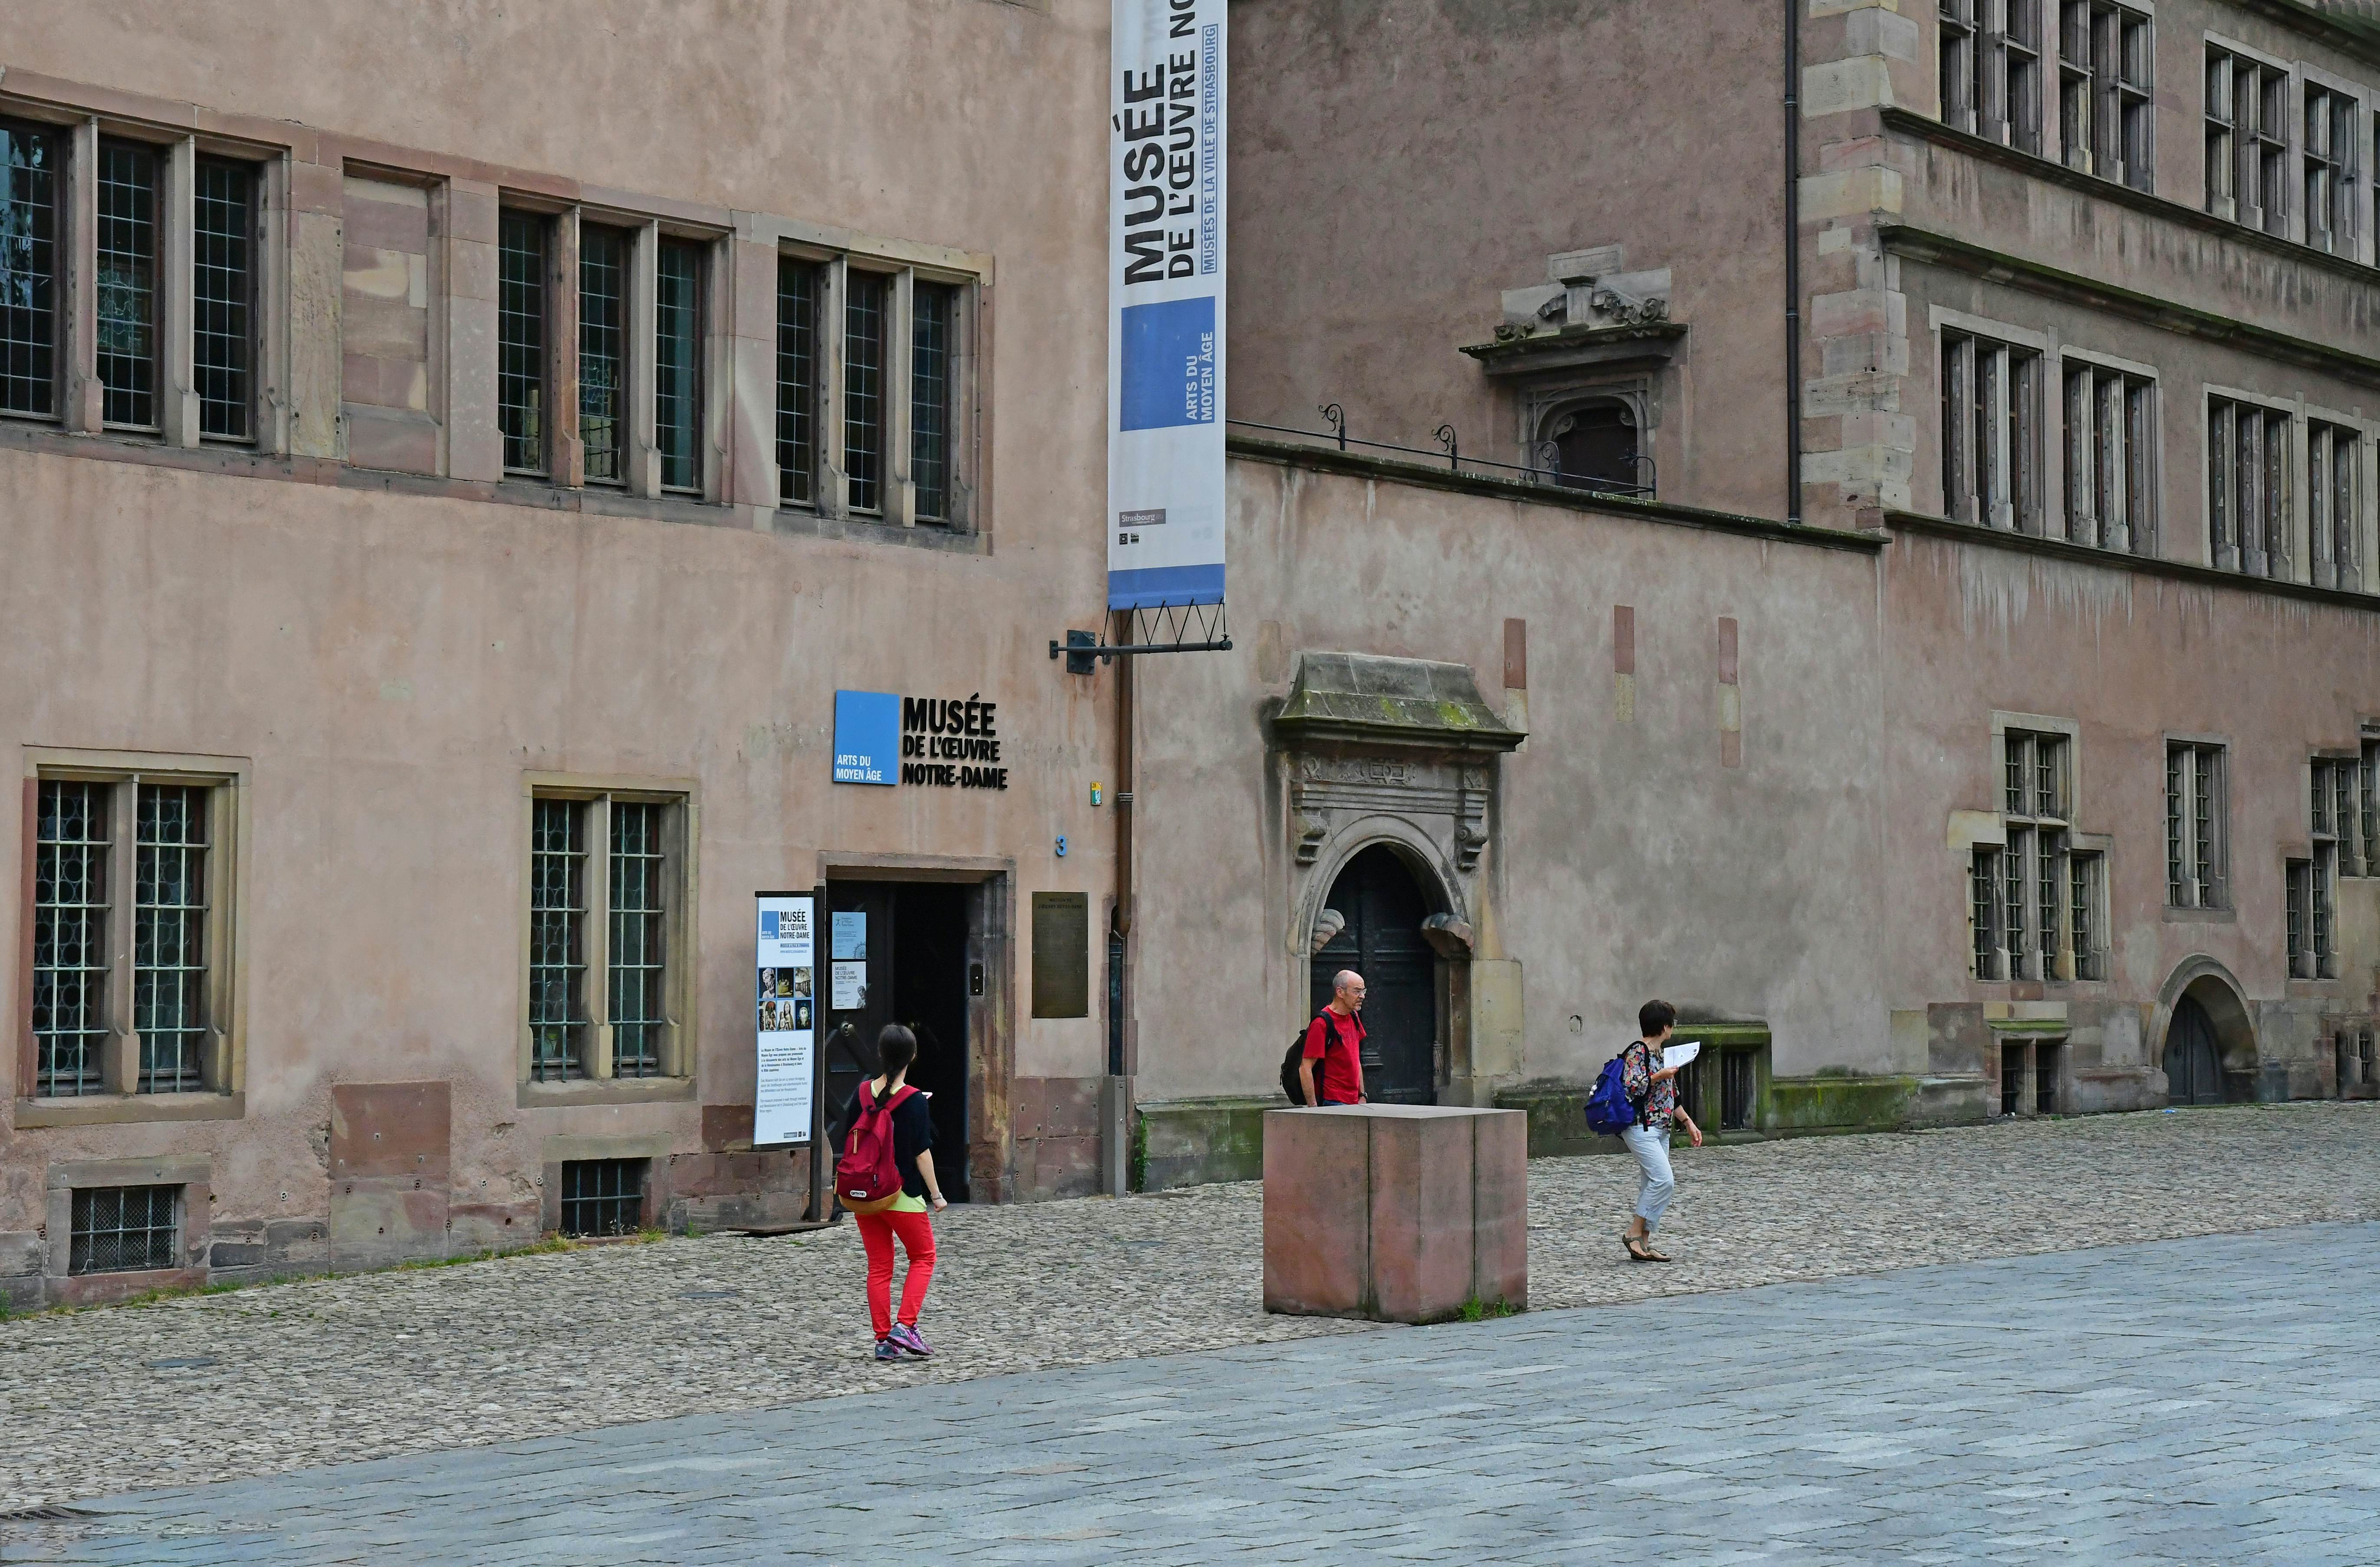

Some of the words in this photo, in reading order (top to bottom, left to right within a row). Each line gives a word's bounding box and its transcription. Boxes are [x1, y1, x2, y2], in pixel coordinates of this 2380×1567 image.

[1205, 27, 1216, 113] STRASBOURG
[1169, 50, 1195, 216] L'ŒUVRE
[1205, 117, 1215, 134] DE
[1204, 138, 1215, 174] VILLE
[1112, 64, 1165, 285] MUSÉE
[1204, 176, 1215, 192] LA
[1204, 196, 1215, 214] DE
[1168, 228, 1194, 279] DE
[1201, 217, 1215, 270] MUSÉES
[1198, 332, 1213, 362] ÂGE
[1186, 355, 1197, 377] DU
[1186, 381, 1197, 420] ARTS
[1201, 368, 1212, 420] MOYEN
[904, 692, 996, 736] MUSÉE
[837, 754, 857, 766] ARTS
[859, 755, 871, 767] DU
[903, 735, 925, 757] DE
[930, 736, 1000, 761] L'ŒUVRE
[836, 768, 864, 781] MOYEN
[865, 767, 881, 781] ÂGE
[902, 762, 1008, 789] NOTRE-DAME
[1056, 835, 1067, 856] 3
[780, 908, 806, 922] MUSÉE
